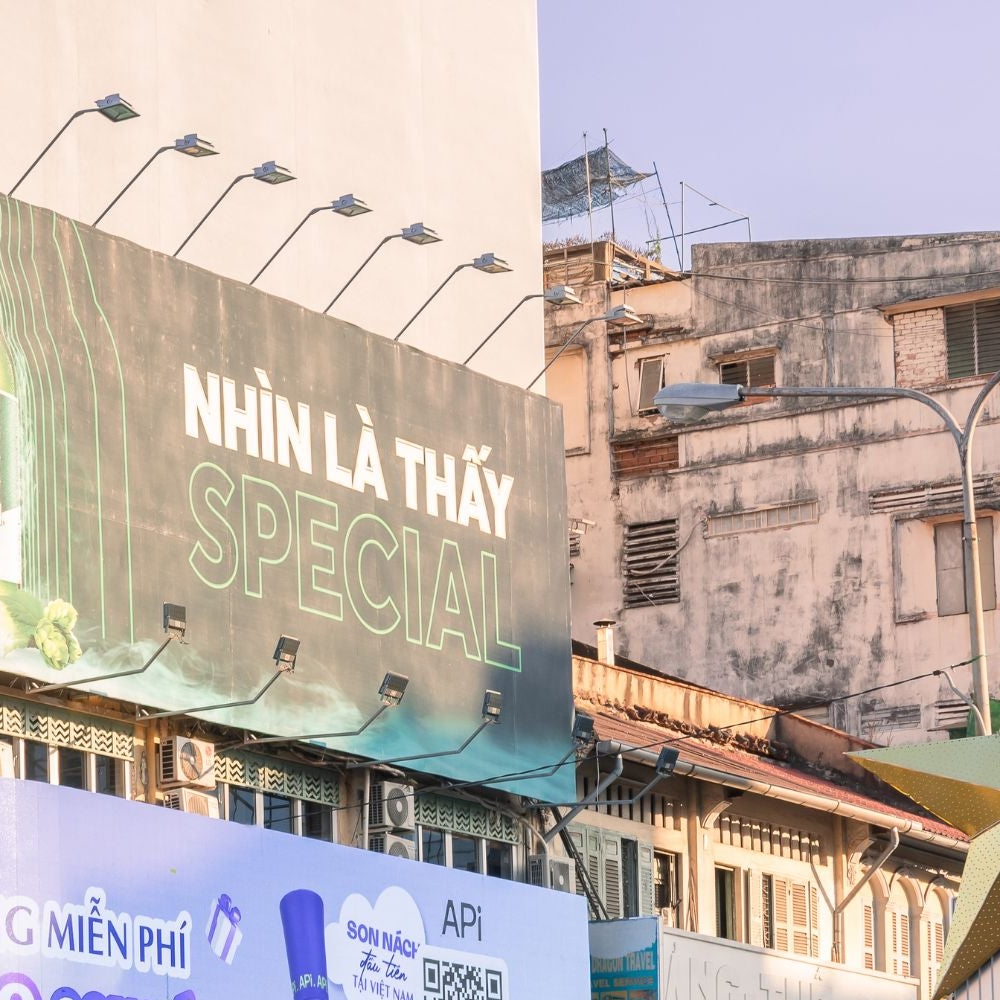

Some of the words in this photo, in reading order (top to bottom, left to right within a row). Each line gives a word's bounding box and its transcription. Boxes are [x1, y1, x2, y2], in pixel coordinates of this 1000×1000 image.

[184, 363, 312, 475] NHÌN
[324, 403, 389, 500] LÀ
[395, 444, 514, 539] THẤY
[189, 462, 522, 672] SPECIAL
[47, 896, 128, 961] MIỄN
[138, 920, 188, 969] PHÍ
[347, 920, 379, 947] SON
[382, 930, 420, 959] NÁCH
[442, 900, 483, 942] APi
[353, 974, 367, 993] TẠI
[370, 979, 390, 1000] VIỆT
